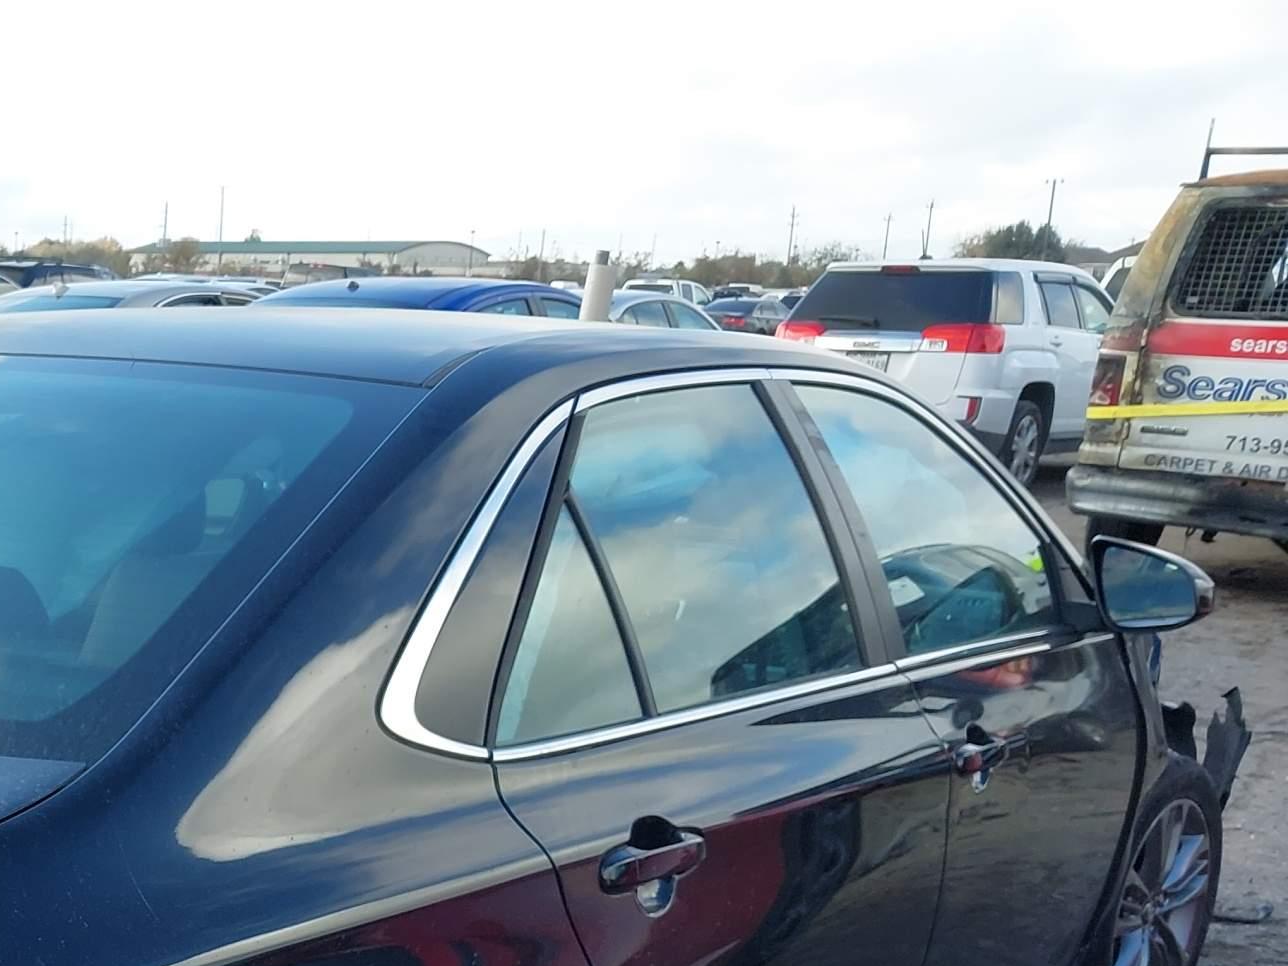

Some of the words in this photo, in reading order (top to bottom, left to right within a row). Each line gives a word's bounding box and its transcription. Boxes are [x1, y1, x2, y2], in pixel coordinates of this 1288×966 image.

[1230, 337, 1288, 354] sears
[1157, 364, 1288, 402] Sears
[1143, 453, 1217, 473] CARPET
[1222, 461, 1234, 474] &
[1238, 463, 1272, 479] AIR
